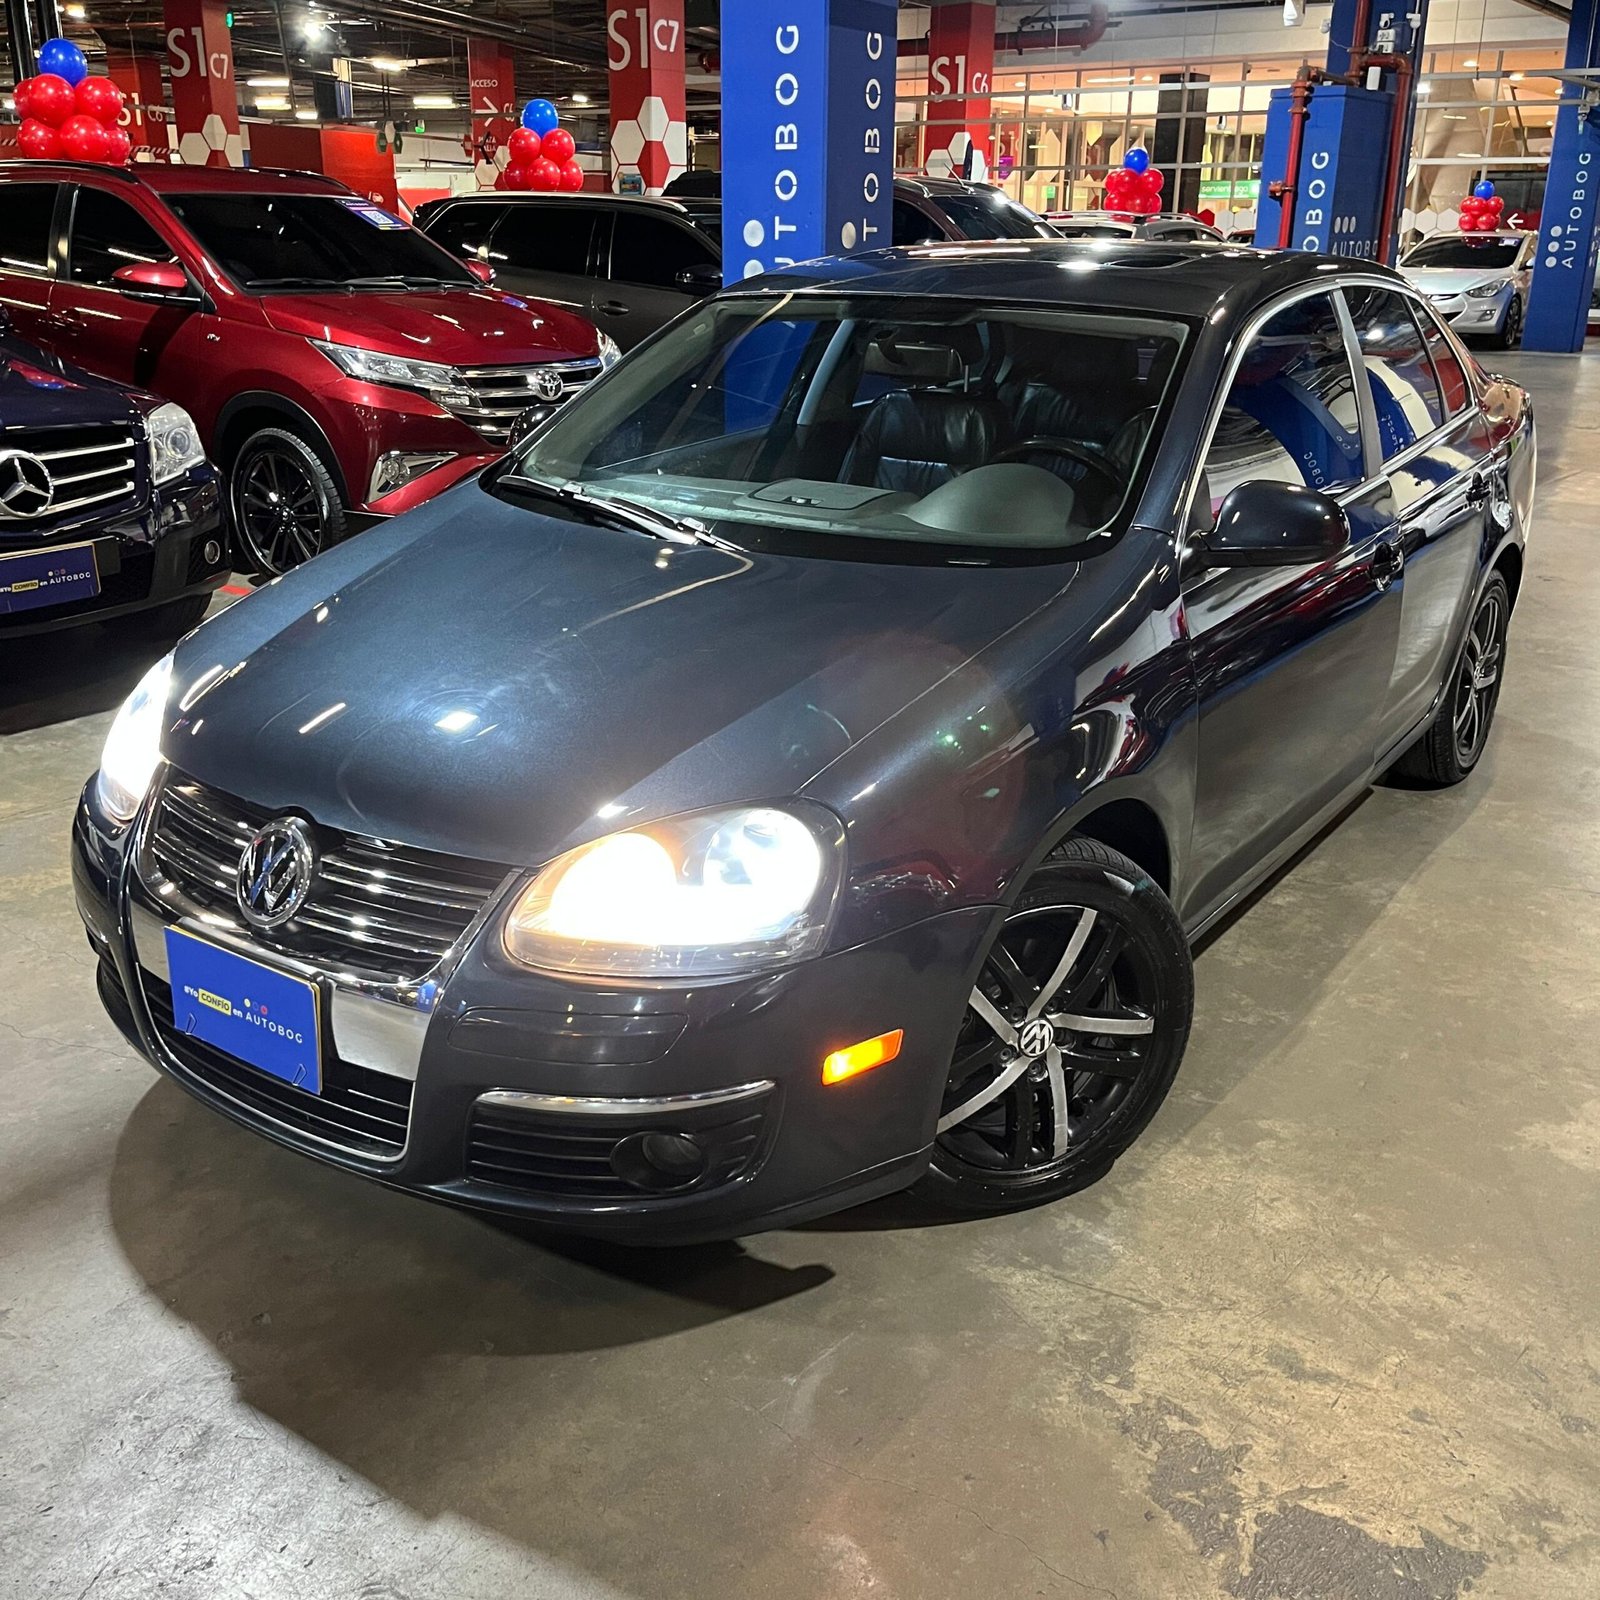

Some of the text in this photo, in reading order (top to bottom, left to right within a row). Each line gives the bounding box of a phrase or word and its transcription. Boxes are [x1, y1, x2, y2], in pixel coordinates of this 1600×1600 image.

[167, 27, 229, 80] S1 C7
[609, 8, 679, 70] S1 C7
[930, 55, 989, 103] S1 C6
[1561, 153, 1591, 269] AUTOBOG
[233, 1008, 242, 1018] en
[245, 1012, 303, 1044] AUTOBOG
